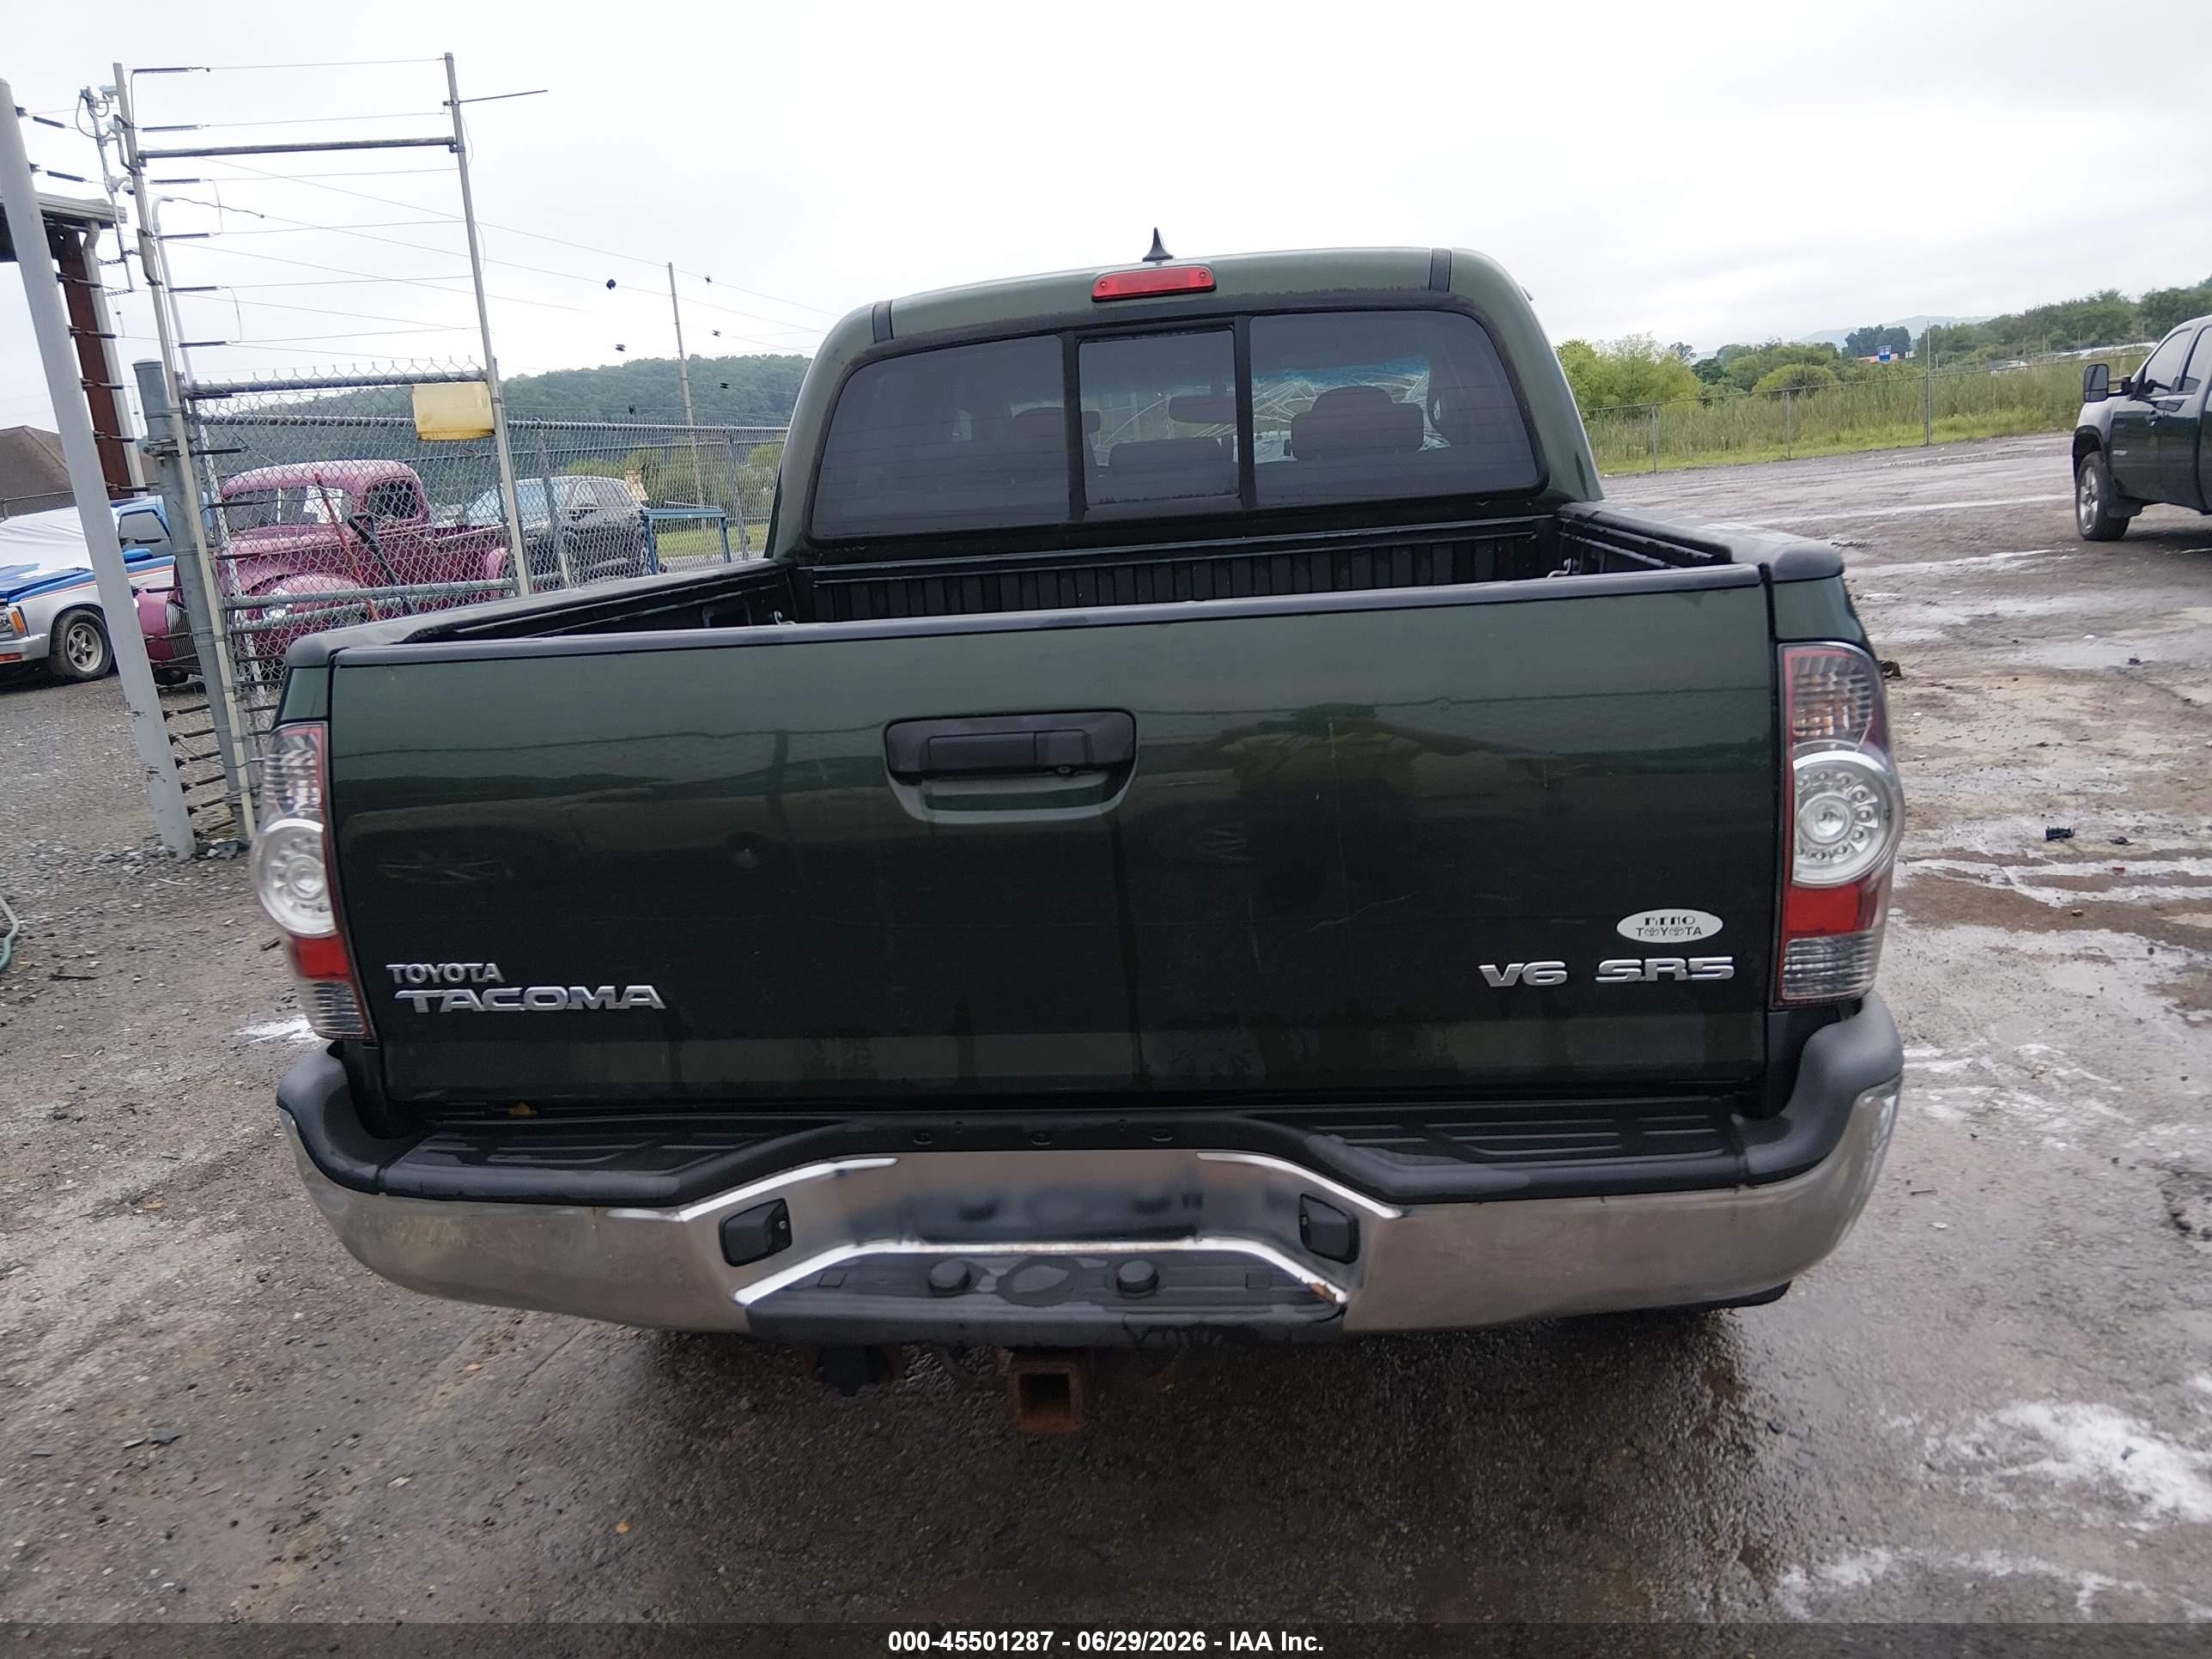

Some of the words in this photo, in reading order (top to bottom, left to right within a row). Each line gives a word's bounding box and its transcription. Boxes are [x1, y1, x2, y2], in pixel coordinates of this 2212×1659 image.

[1636, 927, 1703, 938] TOYOTA
[386, 963, 506, 984] TOYOTA
[1478, 961, 1568, 988] V6
[1595, 957, 1735, 982] SR5
[394, 985, 666, 1013] TACOMA
